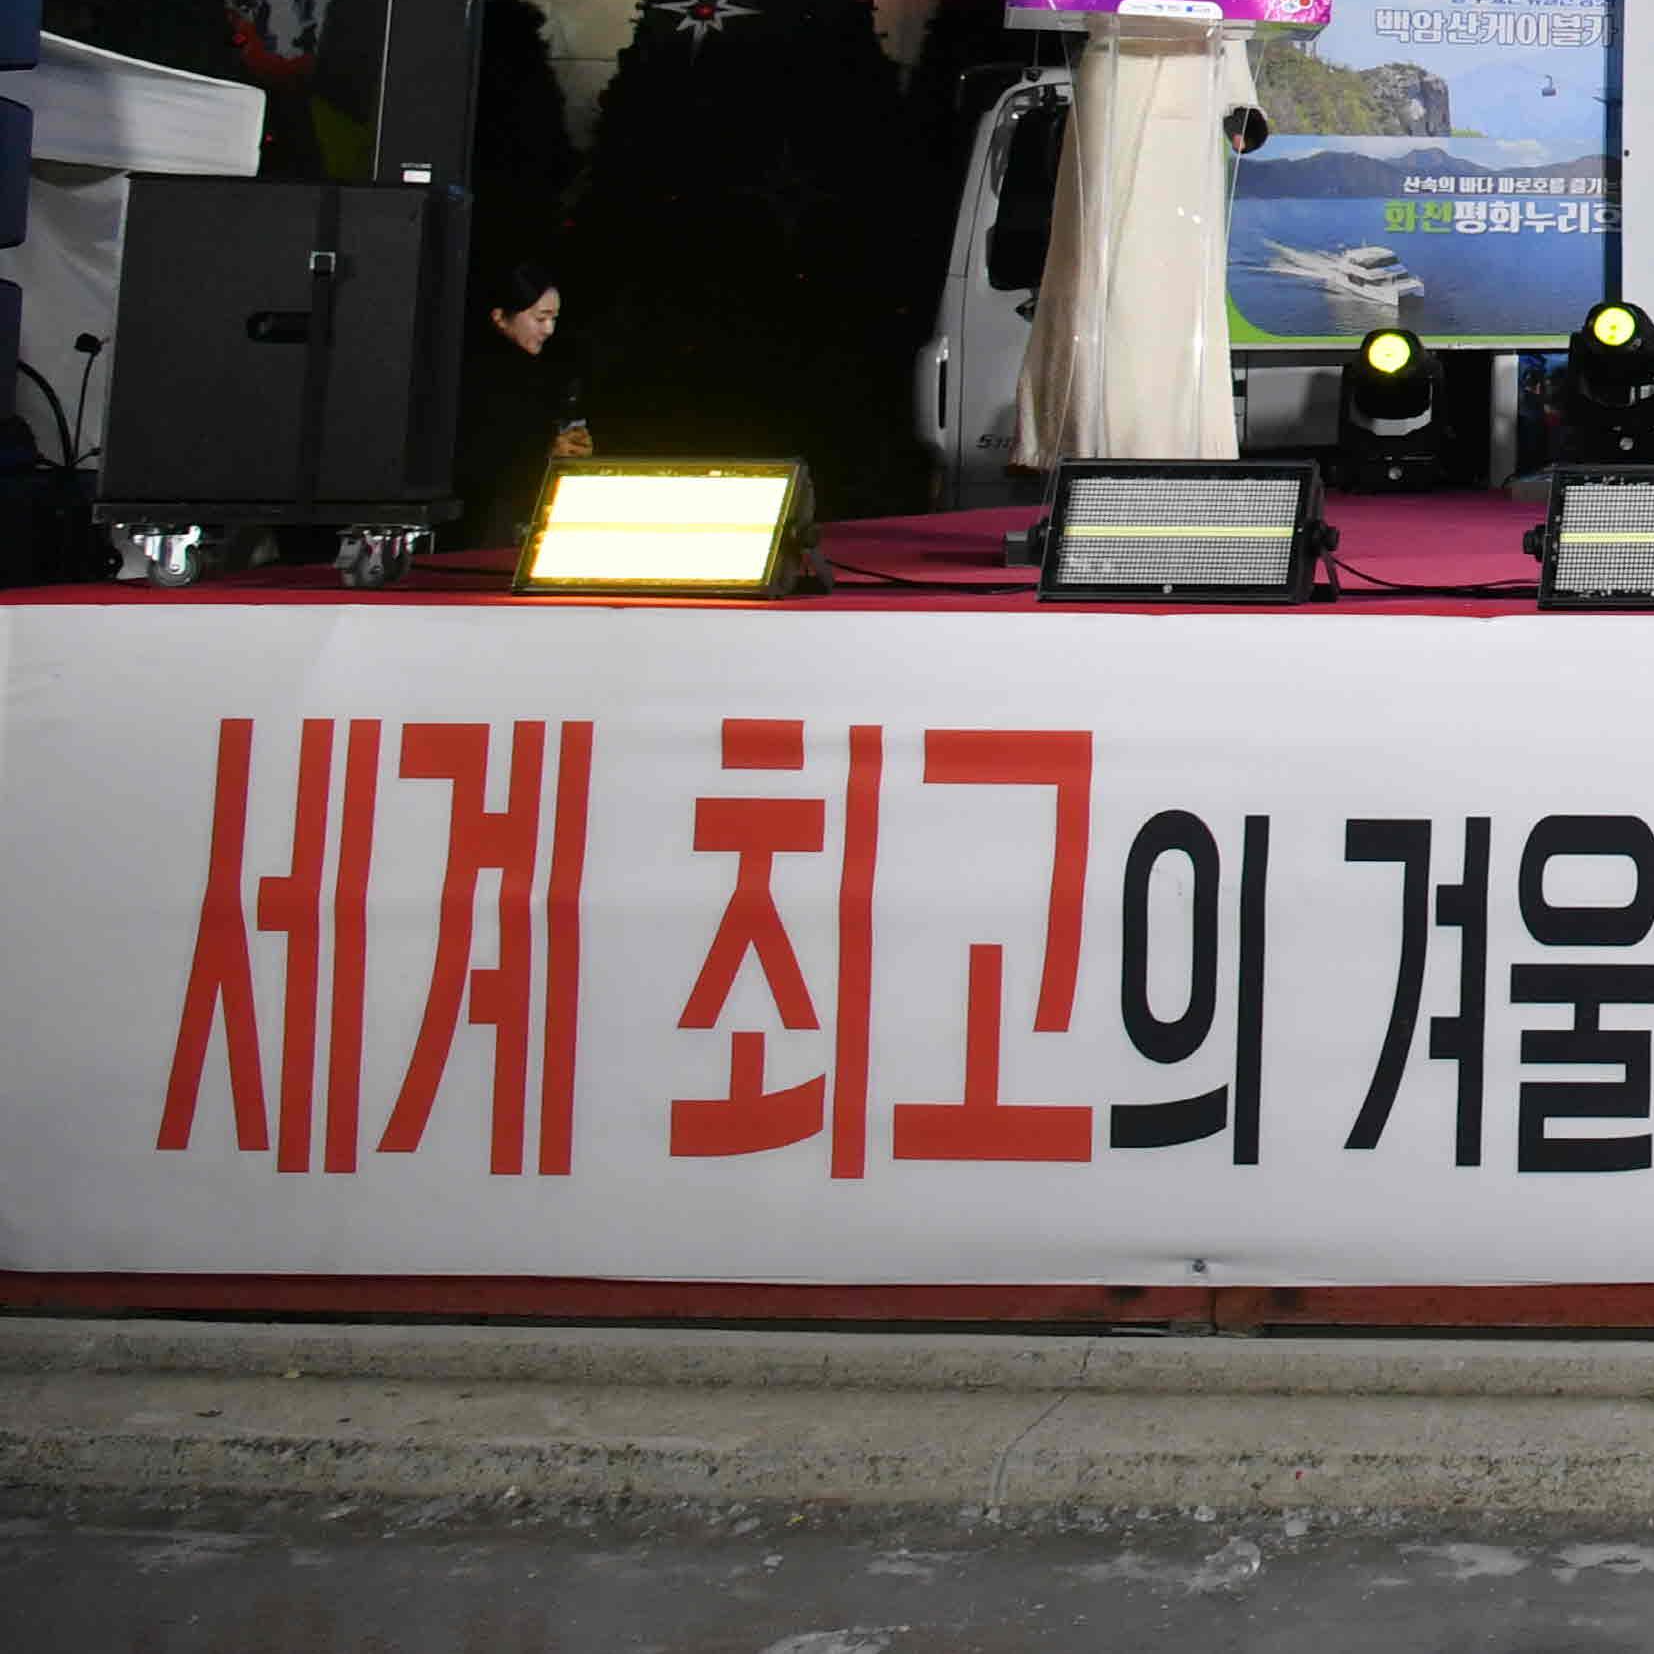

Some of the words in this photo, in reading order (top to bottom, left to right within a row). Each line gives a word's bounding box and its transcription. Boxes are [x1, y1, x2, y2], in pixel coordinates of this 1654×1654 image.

[1403, 177, 1455, 193] 산속의
[1460, 177, 1494, 193] 바다
[156, 718, 594, 1175] 세계
[670, 718, 1270, 1179] 최고의
